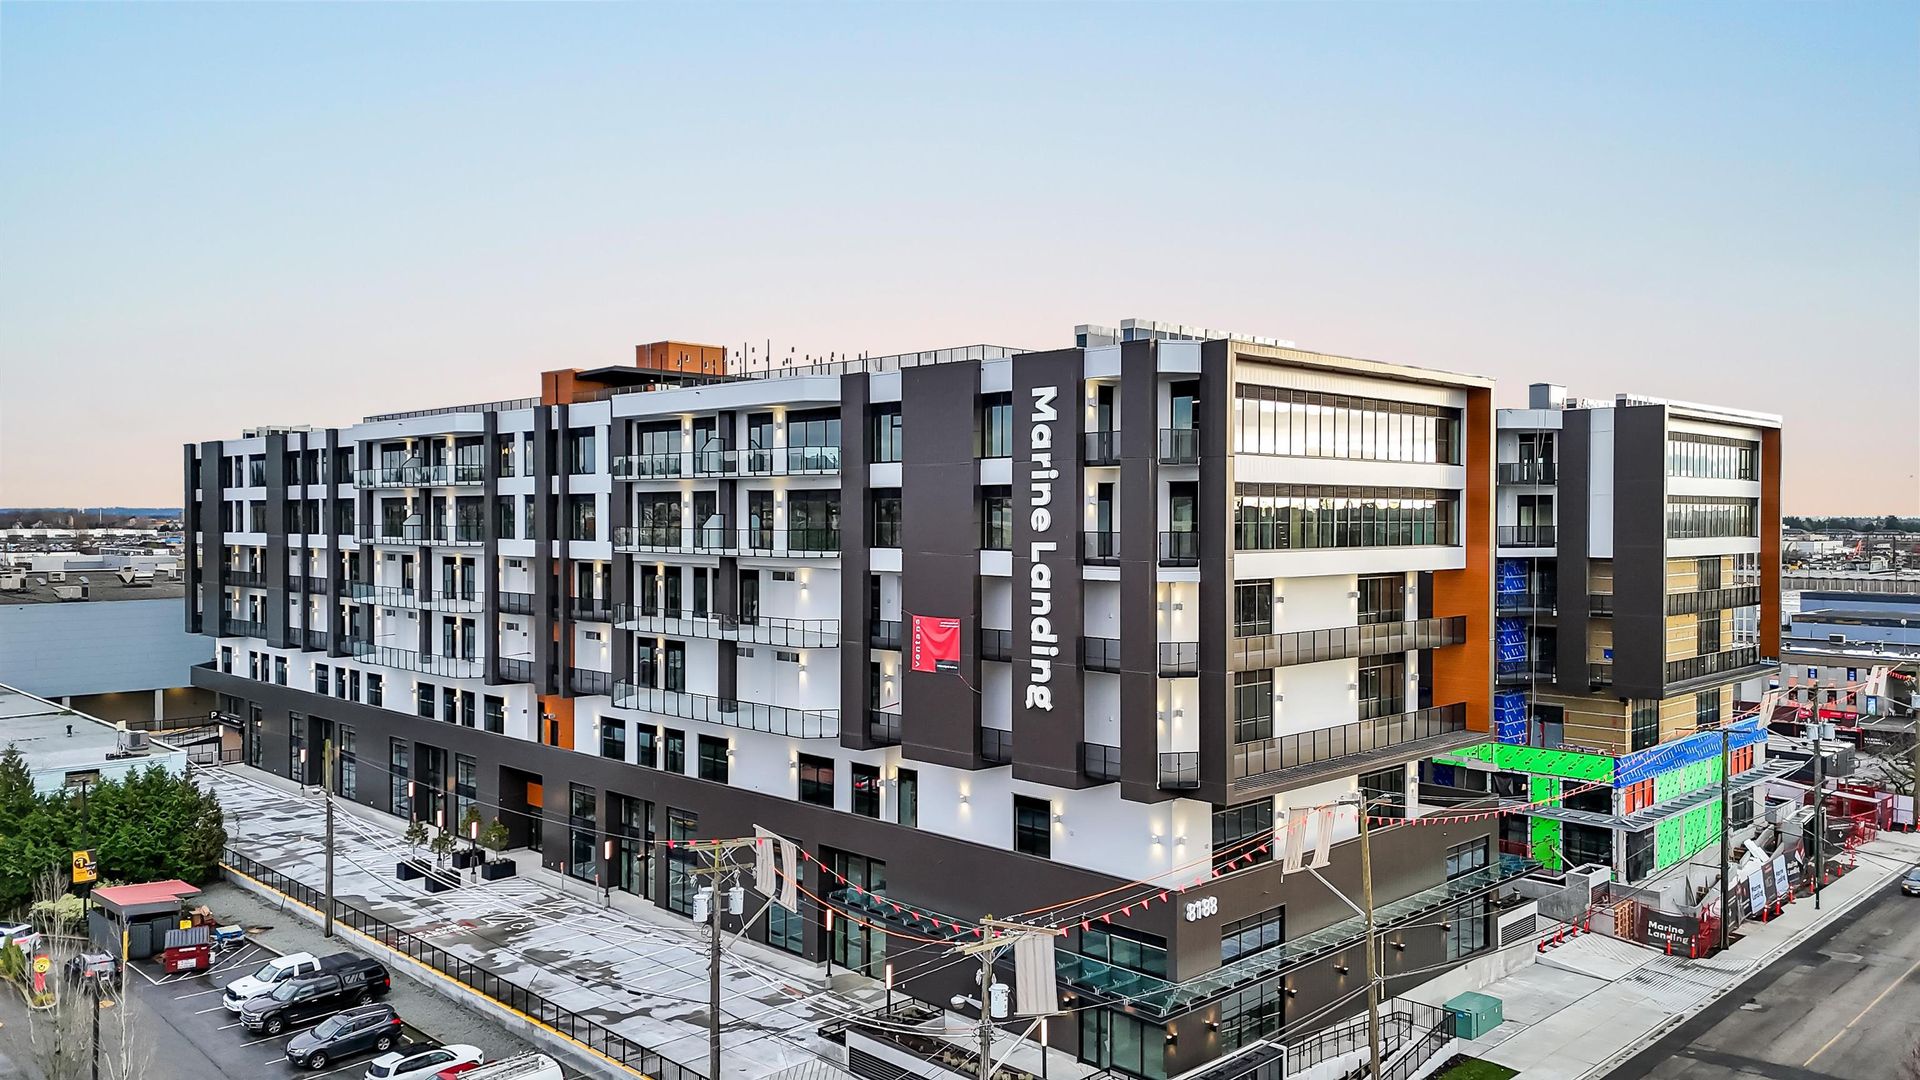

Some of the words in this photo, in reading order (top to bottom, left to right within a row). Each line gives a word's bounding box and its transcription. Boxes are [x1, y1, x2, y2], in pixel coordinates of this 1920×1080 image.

[1031, 386, 1059, 532] Marine
[1025, 542, 1059, 711] Landing
[211, 711, 217, 719] P
[1186, 896, 1218, 921] 8188
[1647, 928, 1690, 945] Landing
[1648, 920, 1685, 934] Marine
